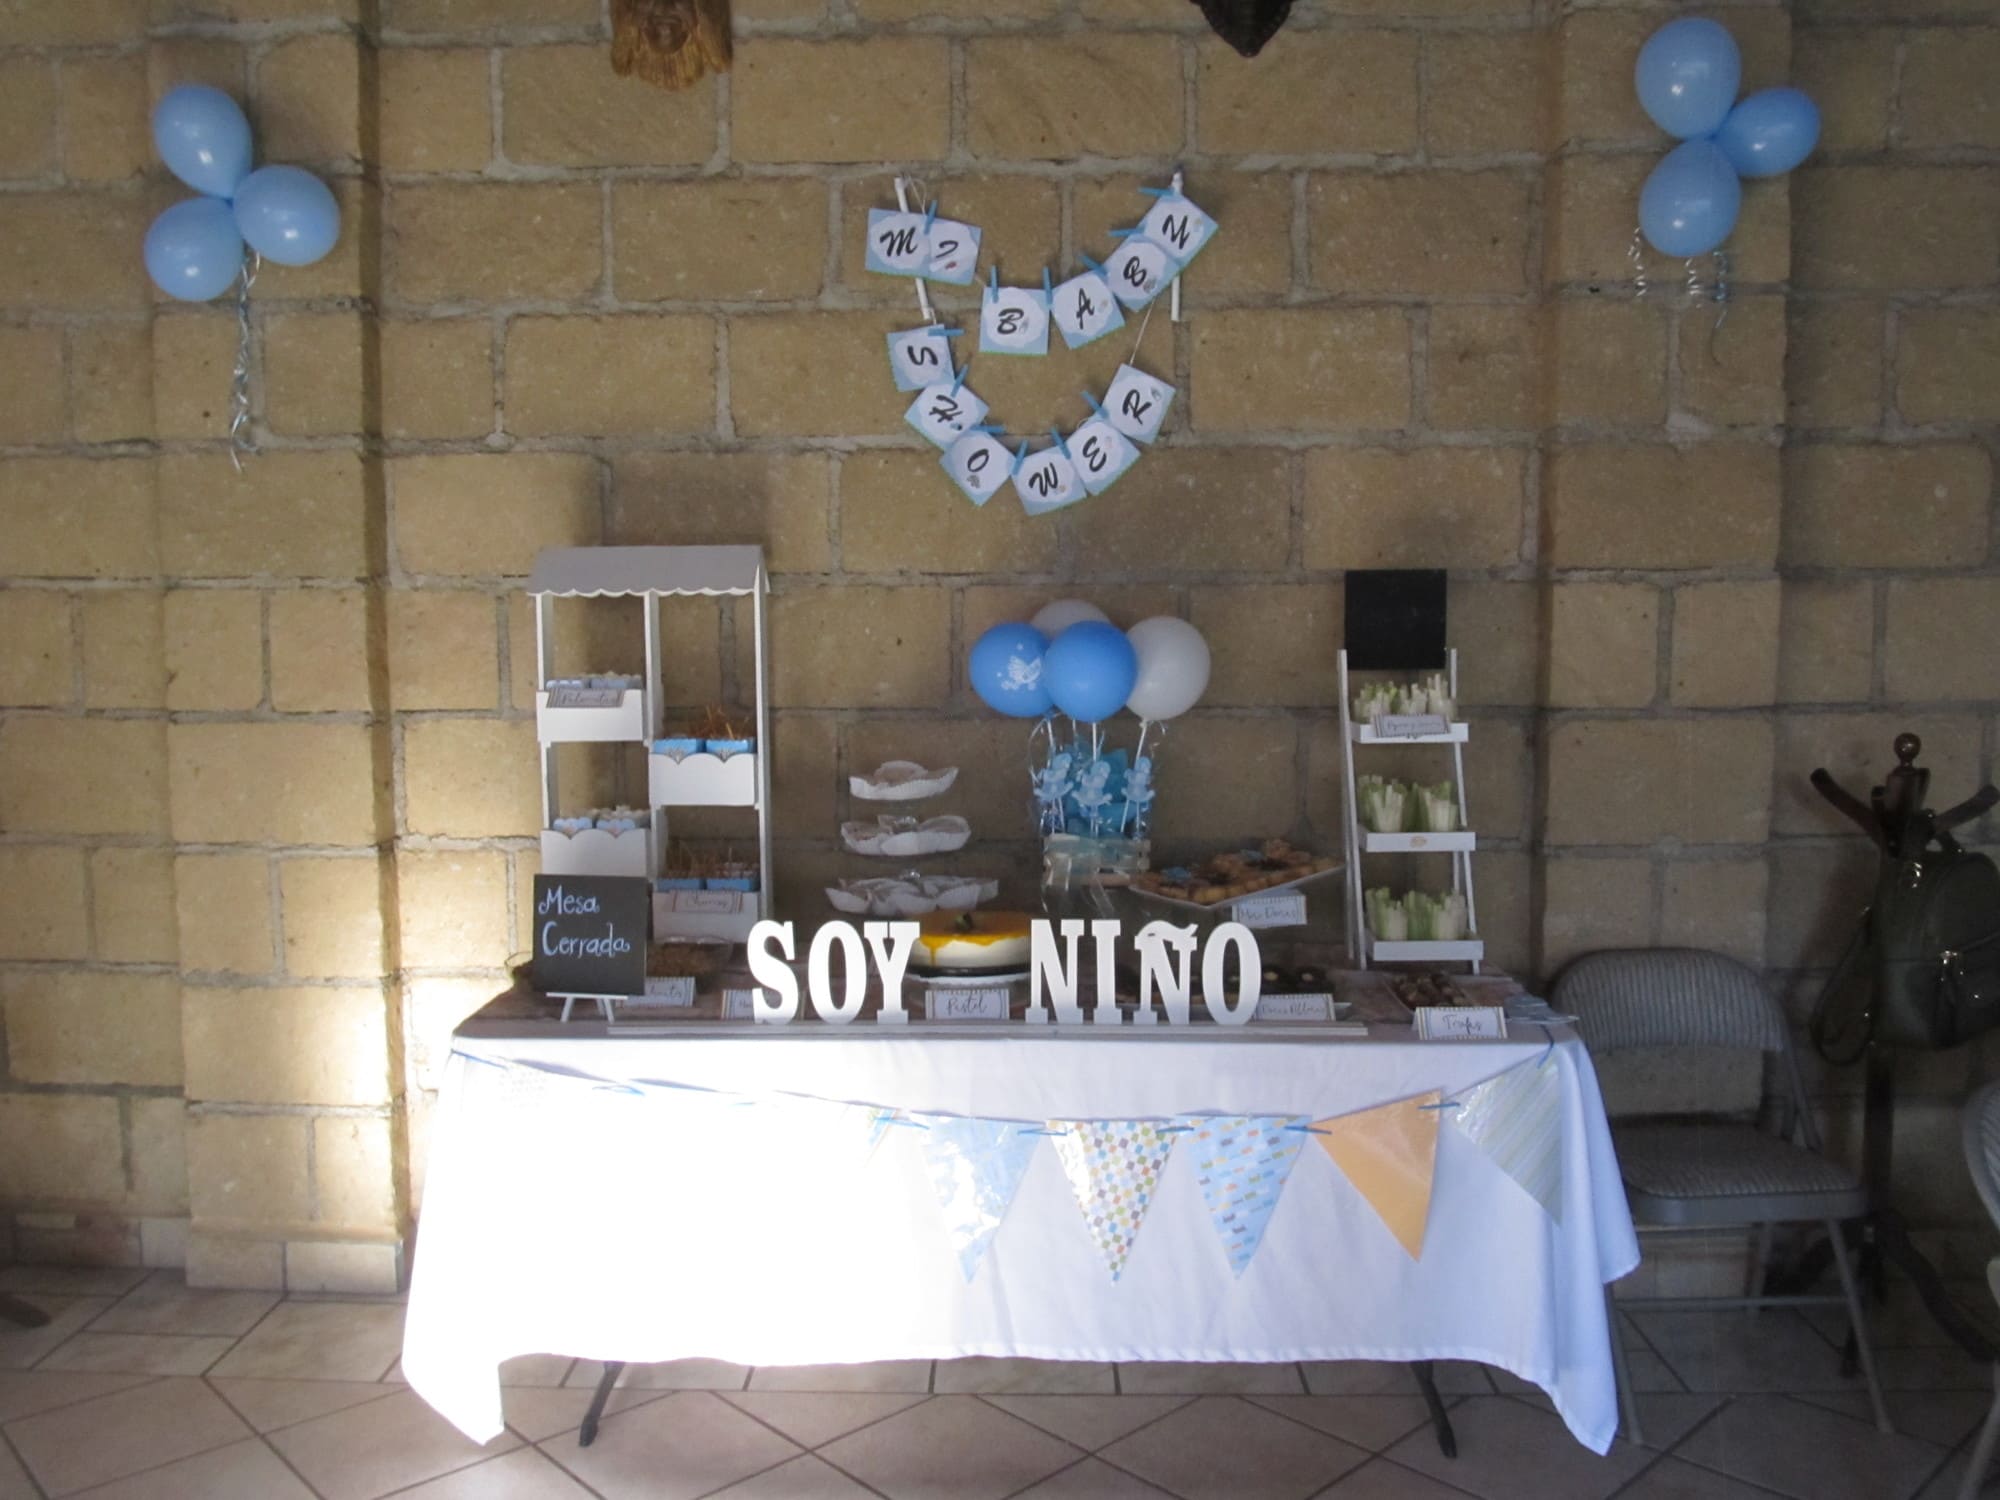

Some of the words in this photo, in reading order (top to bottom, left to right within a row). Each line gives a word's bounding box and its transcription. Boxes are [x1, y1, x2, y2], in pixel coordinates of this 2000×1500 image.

[907, 345, 1152, 497] SHOWER
[539, 885, 600, 915] Mesa
[541, 921, 630, 959] Cerrada
[747, 920, 920, 1025] SOY
[1025, 919, 1261, 1025] NIÑO
